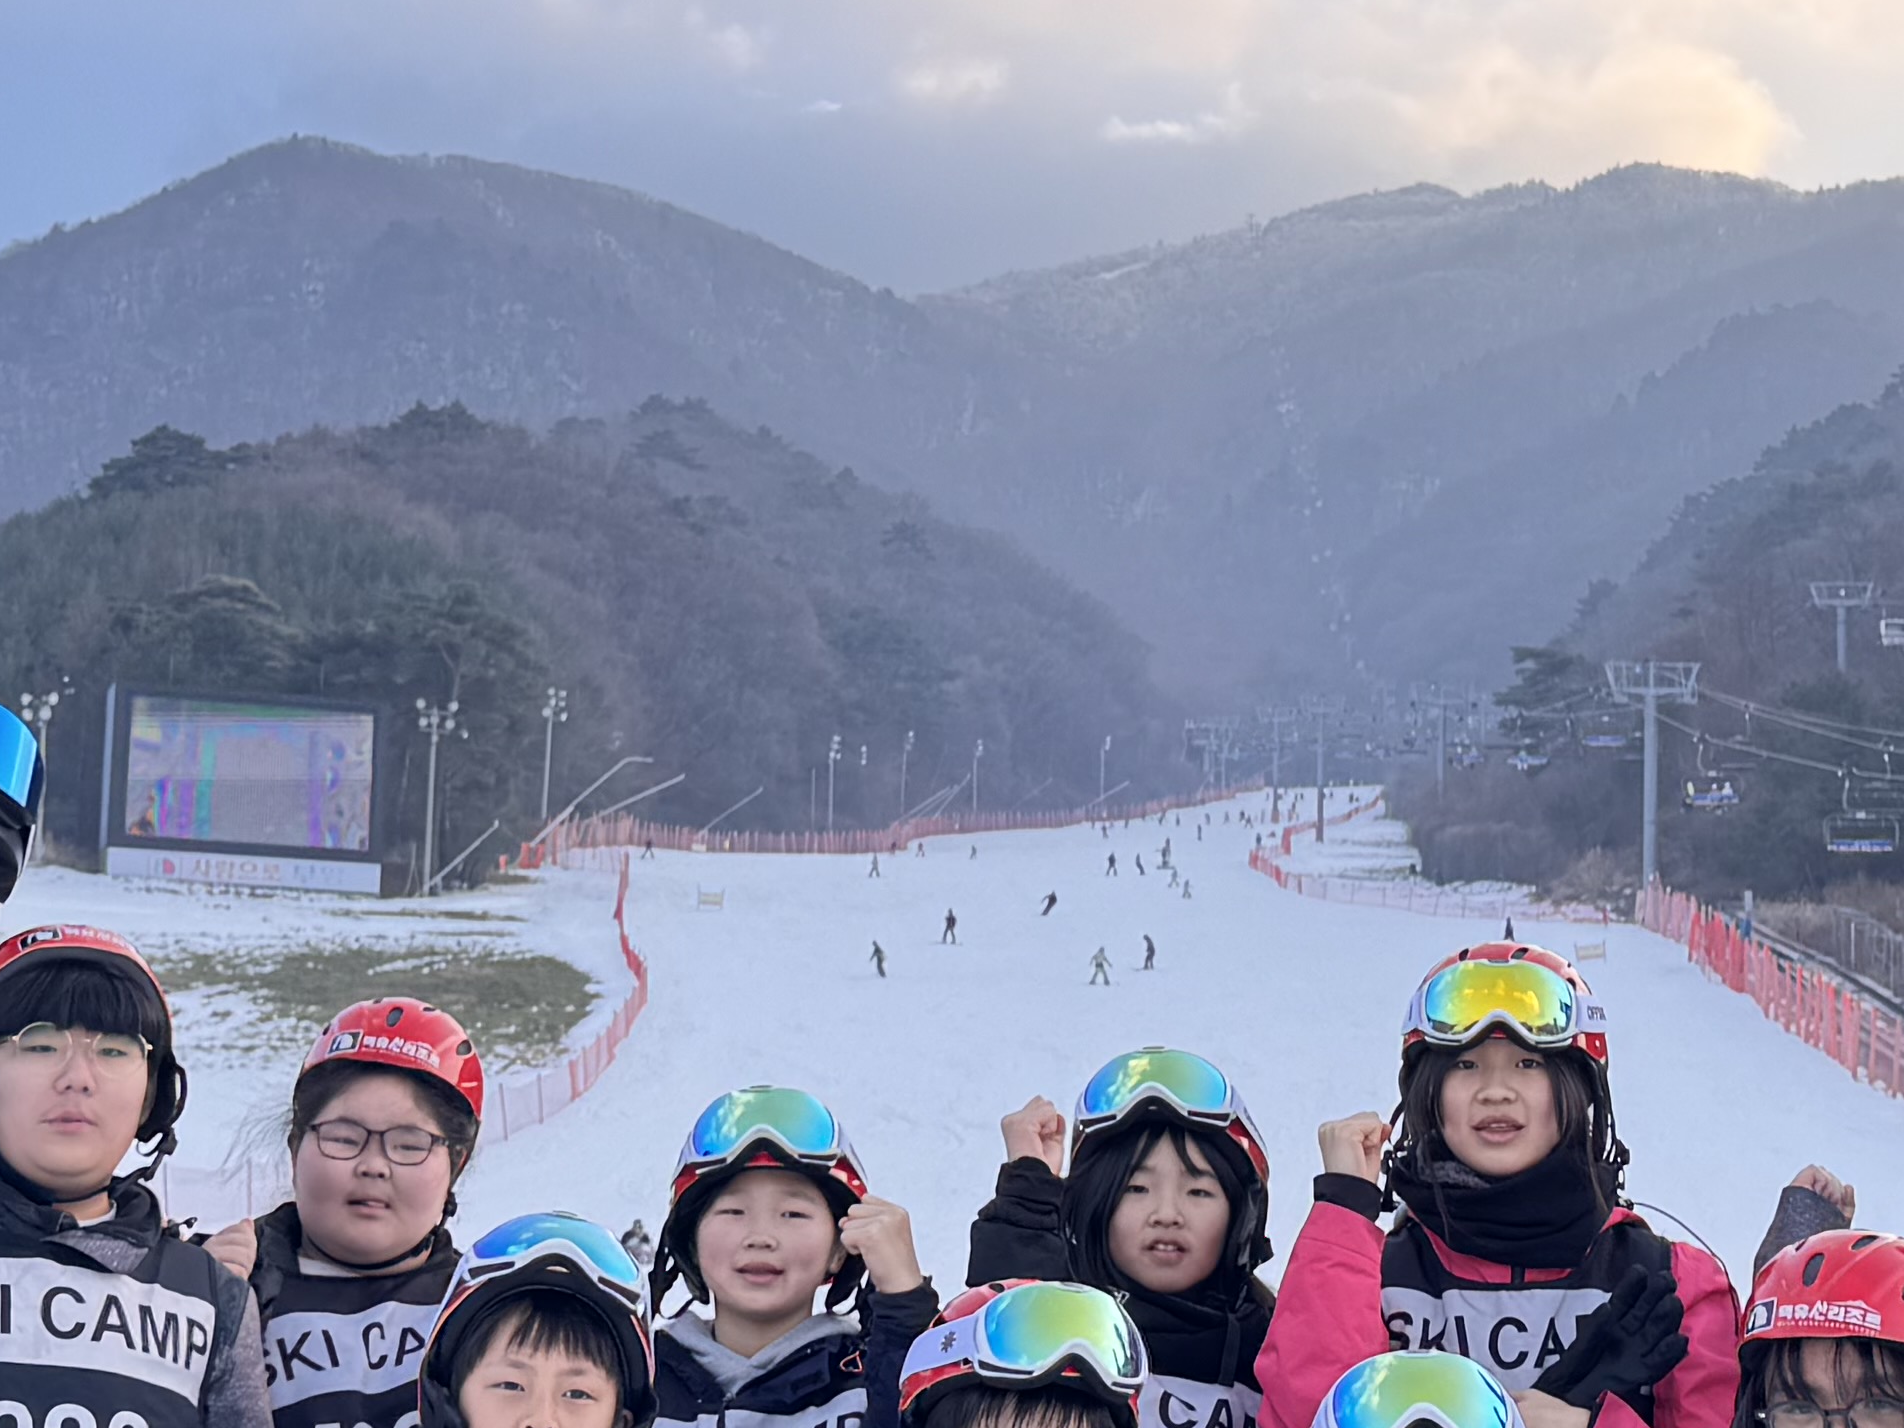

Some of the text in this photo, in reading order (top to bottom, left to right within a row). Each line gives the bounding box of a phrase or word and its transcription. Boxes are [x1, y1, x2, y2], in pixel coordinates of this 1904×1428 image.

[41, 1286, 208, 1370] CAMP
[362, 1321, 426, 1370] CA
[1488, 1316, 1569, 1371] CA
